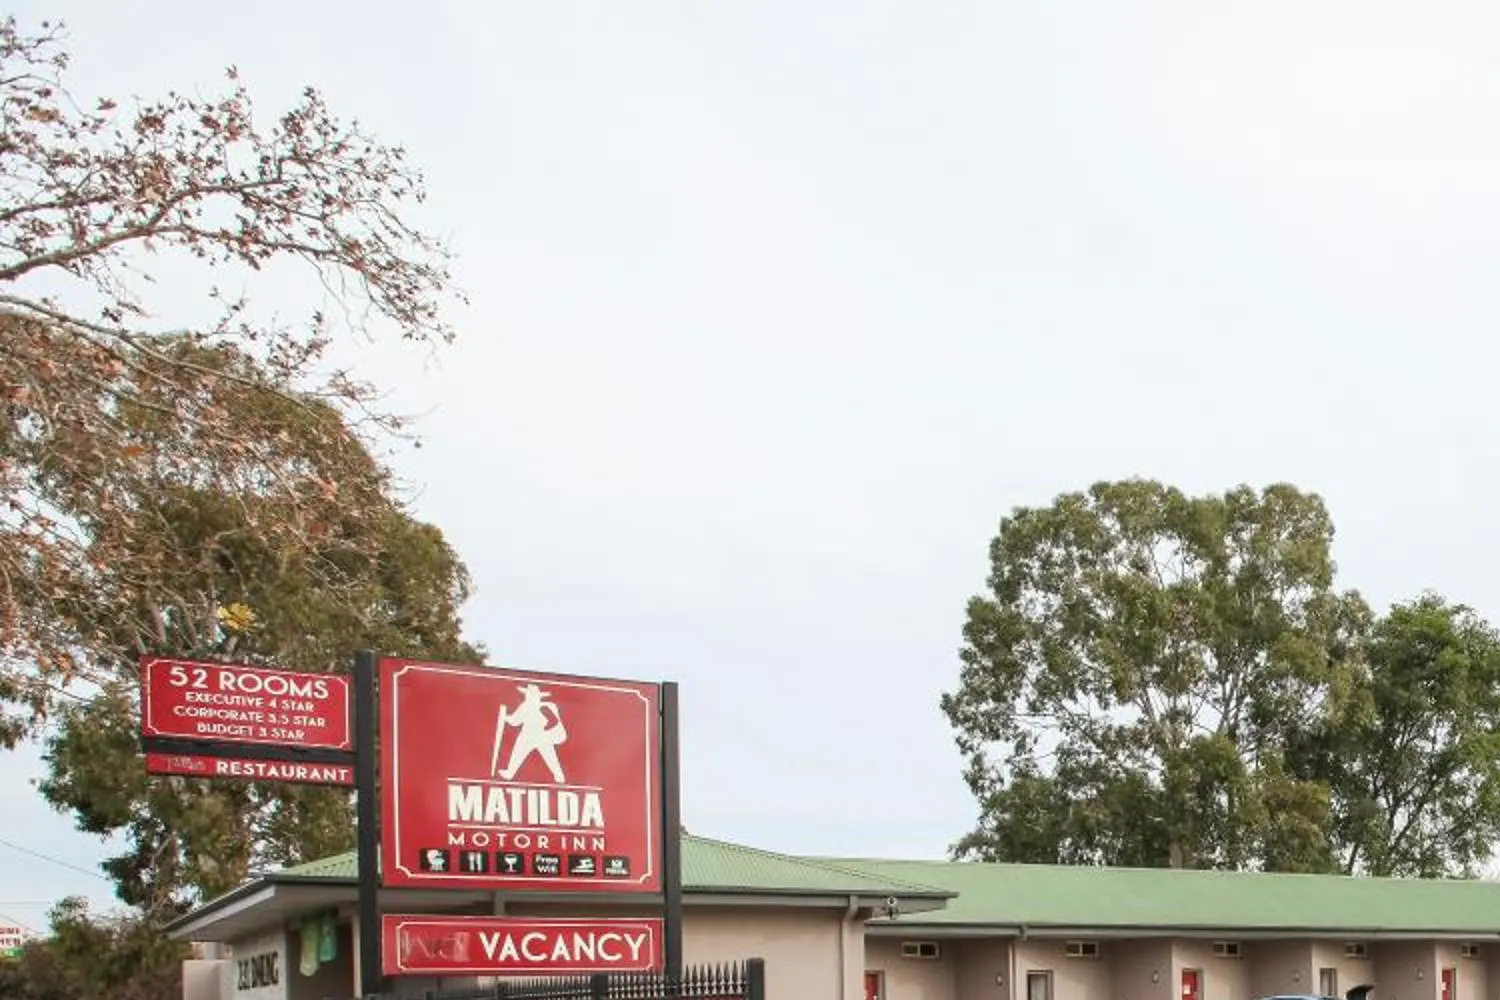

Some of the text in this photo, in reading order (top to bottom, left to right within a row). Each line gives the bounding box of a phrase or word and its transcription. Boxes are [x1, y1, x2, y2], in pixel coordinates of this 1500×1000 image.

[169, 667, 328, 700] 52 ROOMS
[186, 692, 314, 712] EXECUTIVE 4 STAR
[173, 705, 263, 723] CORPORATE
[294, 716, 326, 728] STAR
[197, 722, 253, 736] BUDGET
[271, 728, 305, 740] STAR
[216, 761, 349, 781] RESTAURANT
[448, 784, 605, 828] MATILDA
[448, 831, 605, 851] MOTOR INN
[479, 931, 647, 961] VACANCY
